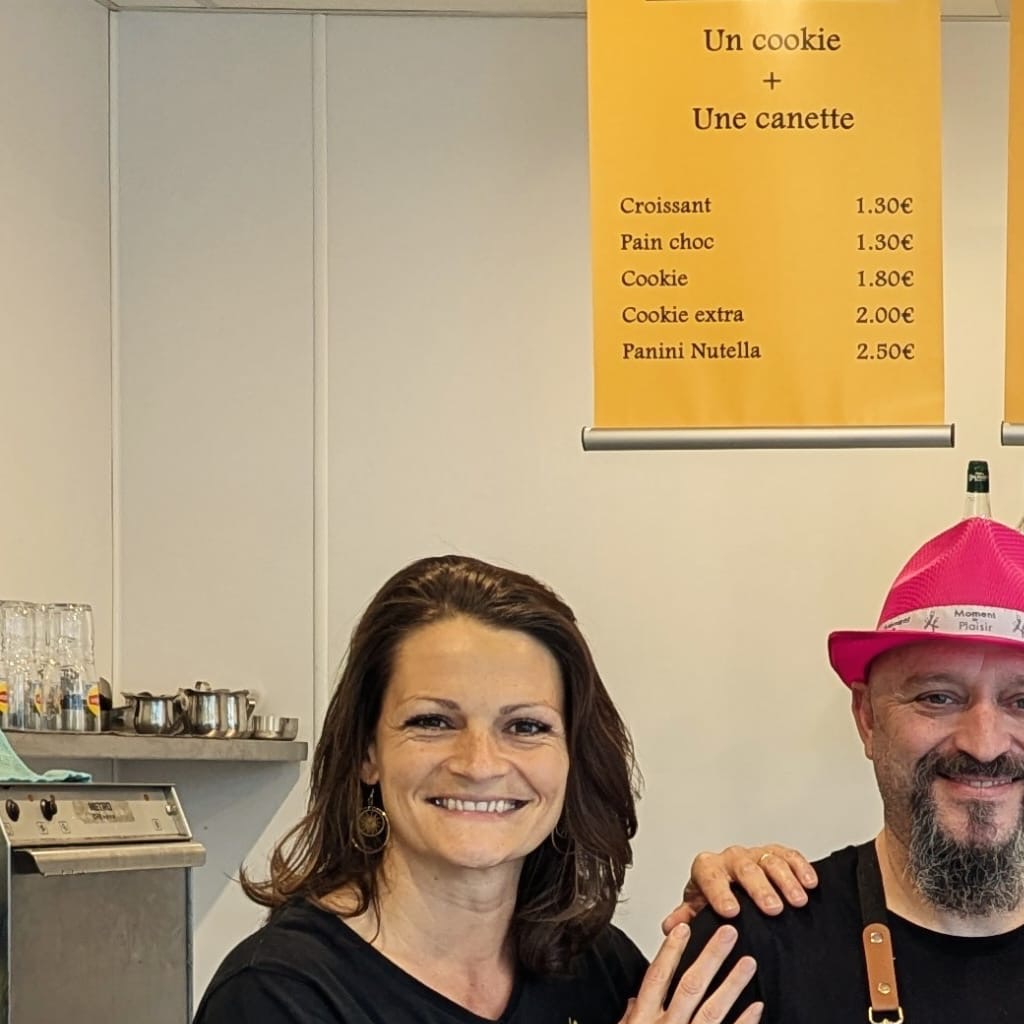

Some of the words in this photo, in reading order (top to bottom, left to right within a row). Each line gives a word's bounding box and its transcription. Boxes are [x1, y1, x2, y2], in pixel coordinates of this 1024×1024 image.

[704, 29, 743, 51] Un
[753, 27, 841, 51] cookie
[693, 108, 746, 130] Une
[756, 109, 854, 129] canette
[621, 197, 711, 214] Croissant
[857, 198, 912, 214] 1.30€
[621, 233, 663, 250] Pain
[670, 232, 714, 250] choc
[858, 234, 913, 250] 1.30€
[622, 269, 688, 286] Cookie
[858, 271, 913, 287] 1.80€
[622, 306, 688, 323] Cookie
[695, 307, 744, 322] extra
[856, 307, 914, 323] 2.00€
[623, 342, 684, 359] Panini
[691, 341, 761, 358] Nutella
[857, 343, 914, 360] 2.50€
[954, 609, 996, 619] Moment
[958, 621, 993, 632] Plaisir
